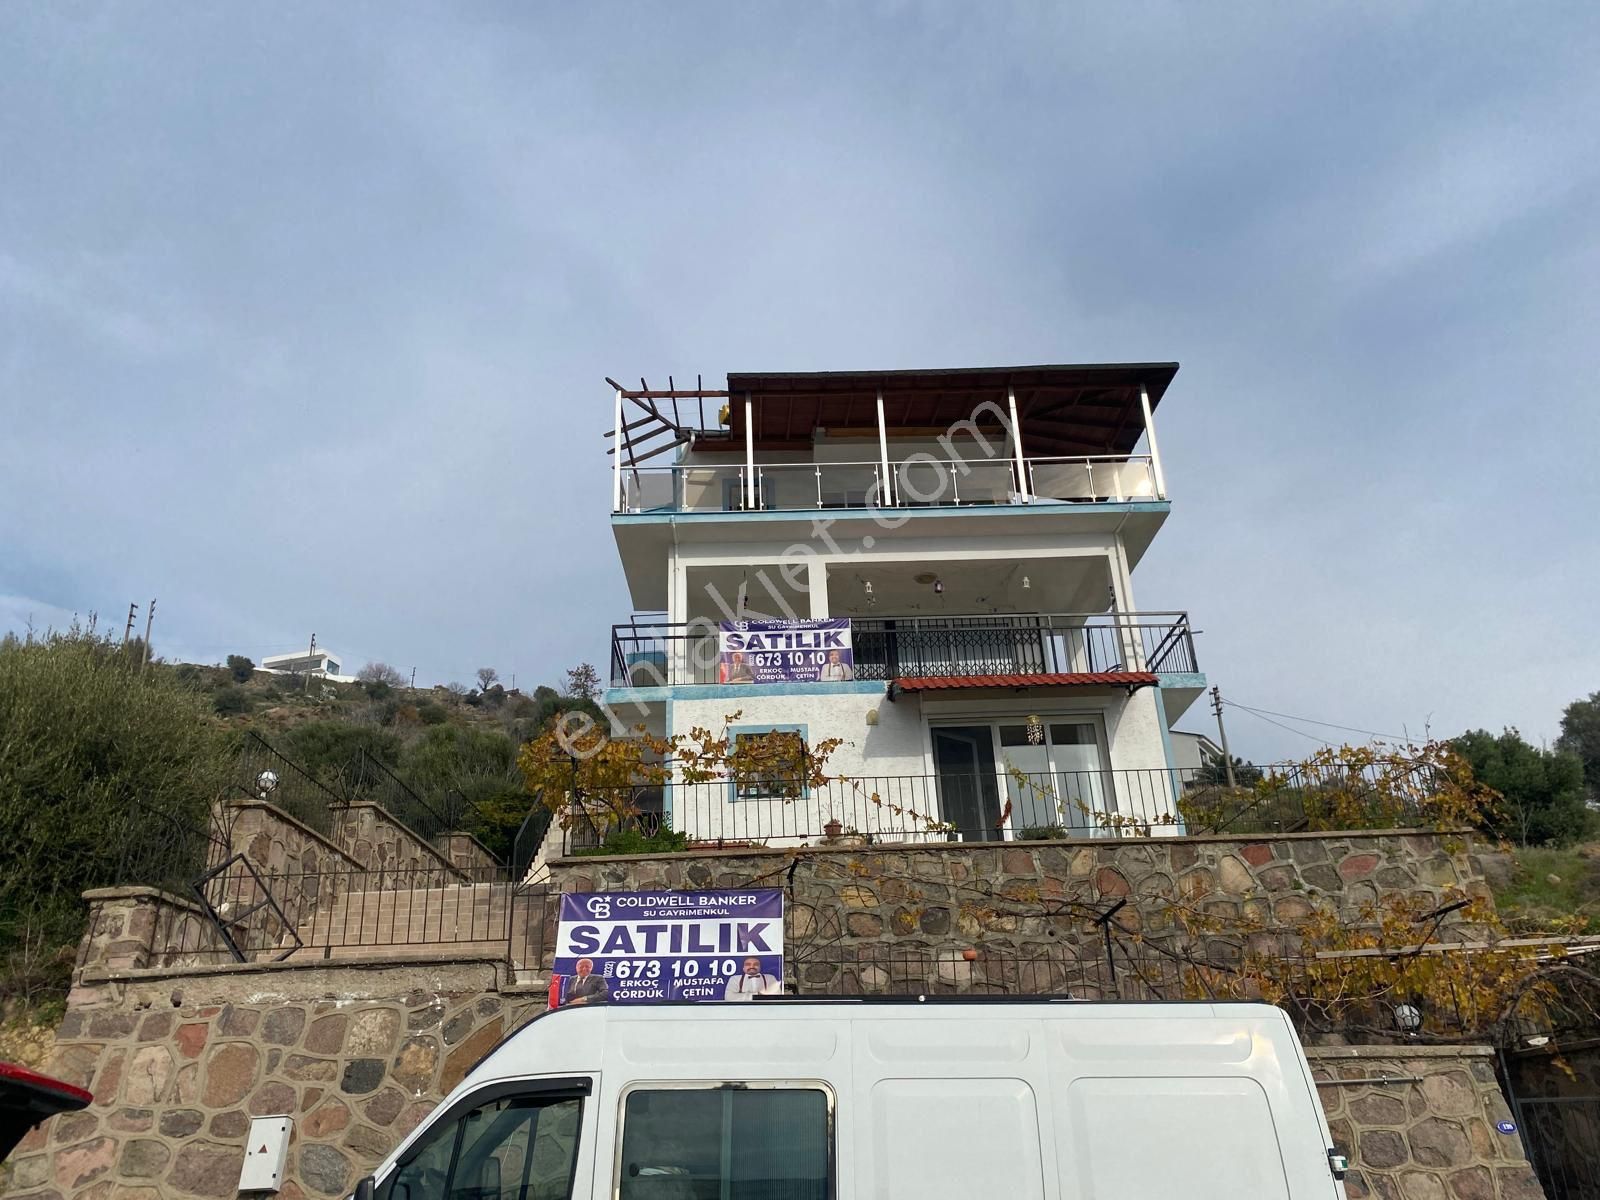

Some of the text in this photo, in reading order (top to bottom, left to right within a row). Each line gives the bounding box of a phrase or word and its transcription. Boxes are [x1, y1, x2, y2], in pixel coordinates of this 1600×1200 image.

[726, 631, 845, 650] SATILIK
[756, 652, 782, 667] 673
[788, 652, 804, 666] 10
[809, 651, 826, 665] 10
[616, 895, 757, 908] COLDWELL BANKER
[643, 909, 657, 917] SU
[568, 922, 773, 955] SATILIK
[616, 959, 737, 979] 673 10 10
[620, 979, 659, 989] ERKOÇ
[673, 977, 725, 987] MUSTAFA
[613, 988, 664, 1000] ÇÖRDÜK
[682, 986, 714, 998] ÇETİN
